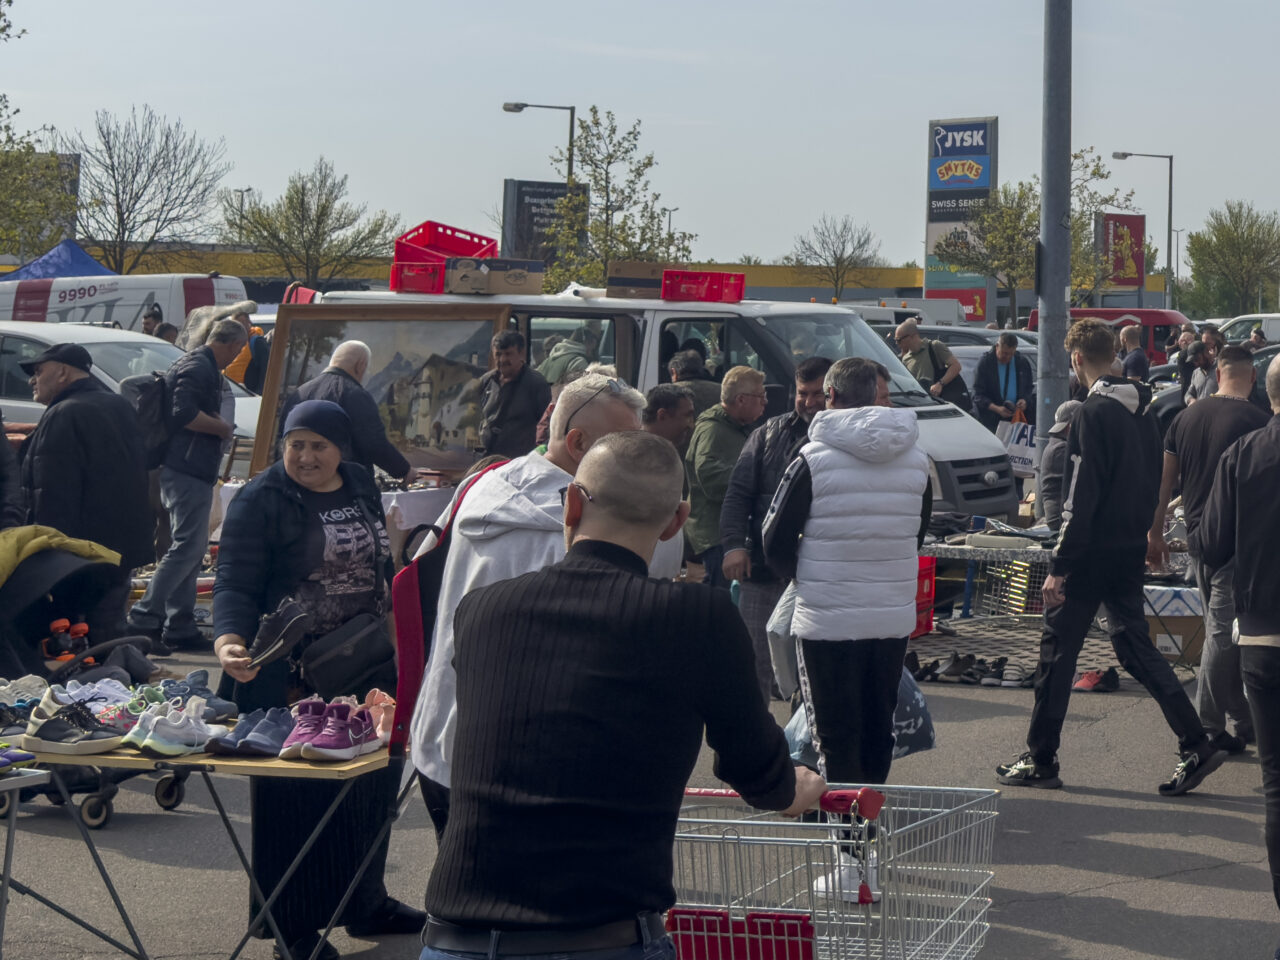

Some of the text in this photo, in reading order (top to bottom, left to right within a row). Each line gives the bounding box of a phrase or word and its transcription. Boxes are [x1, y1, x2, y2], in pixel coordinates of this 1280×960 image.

[944, 129, 984, 148] JYSK
[937, 160, 983, 180] SMYTHS
[931, 200, 957, 209] SWISS
[58, 284, 97, 303] 9990
